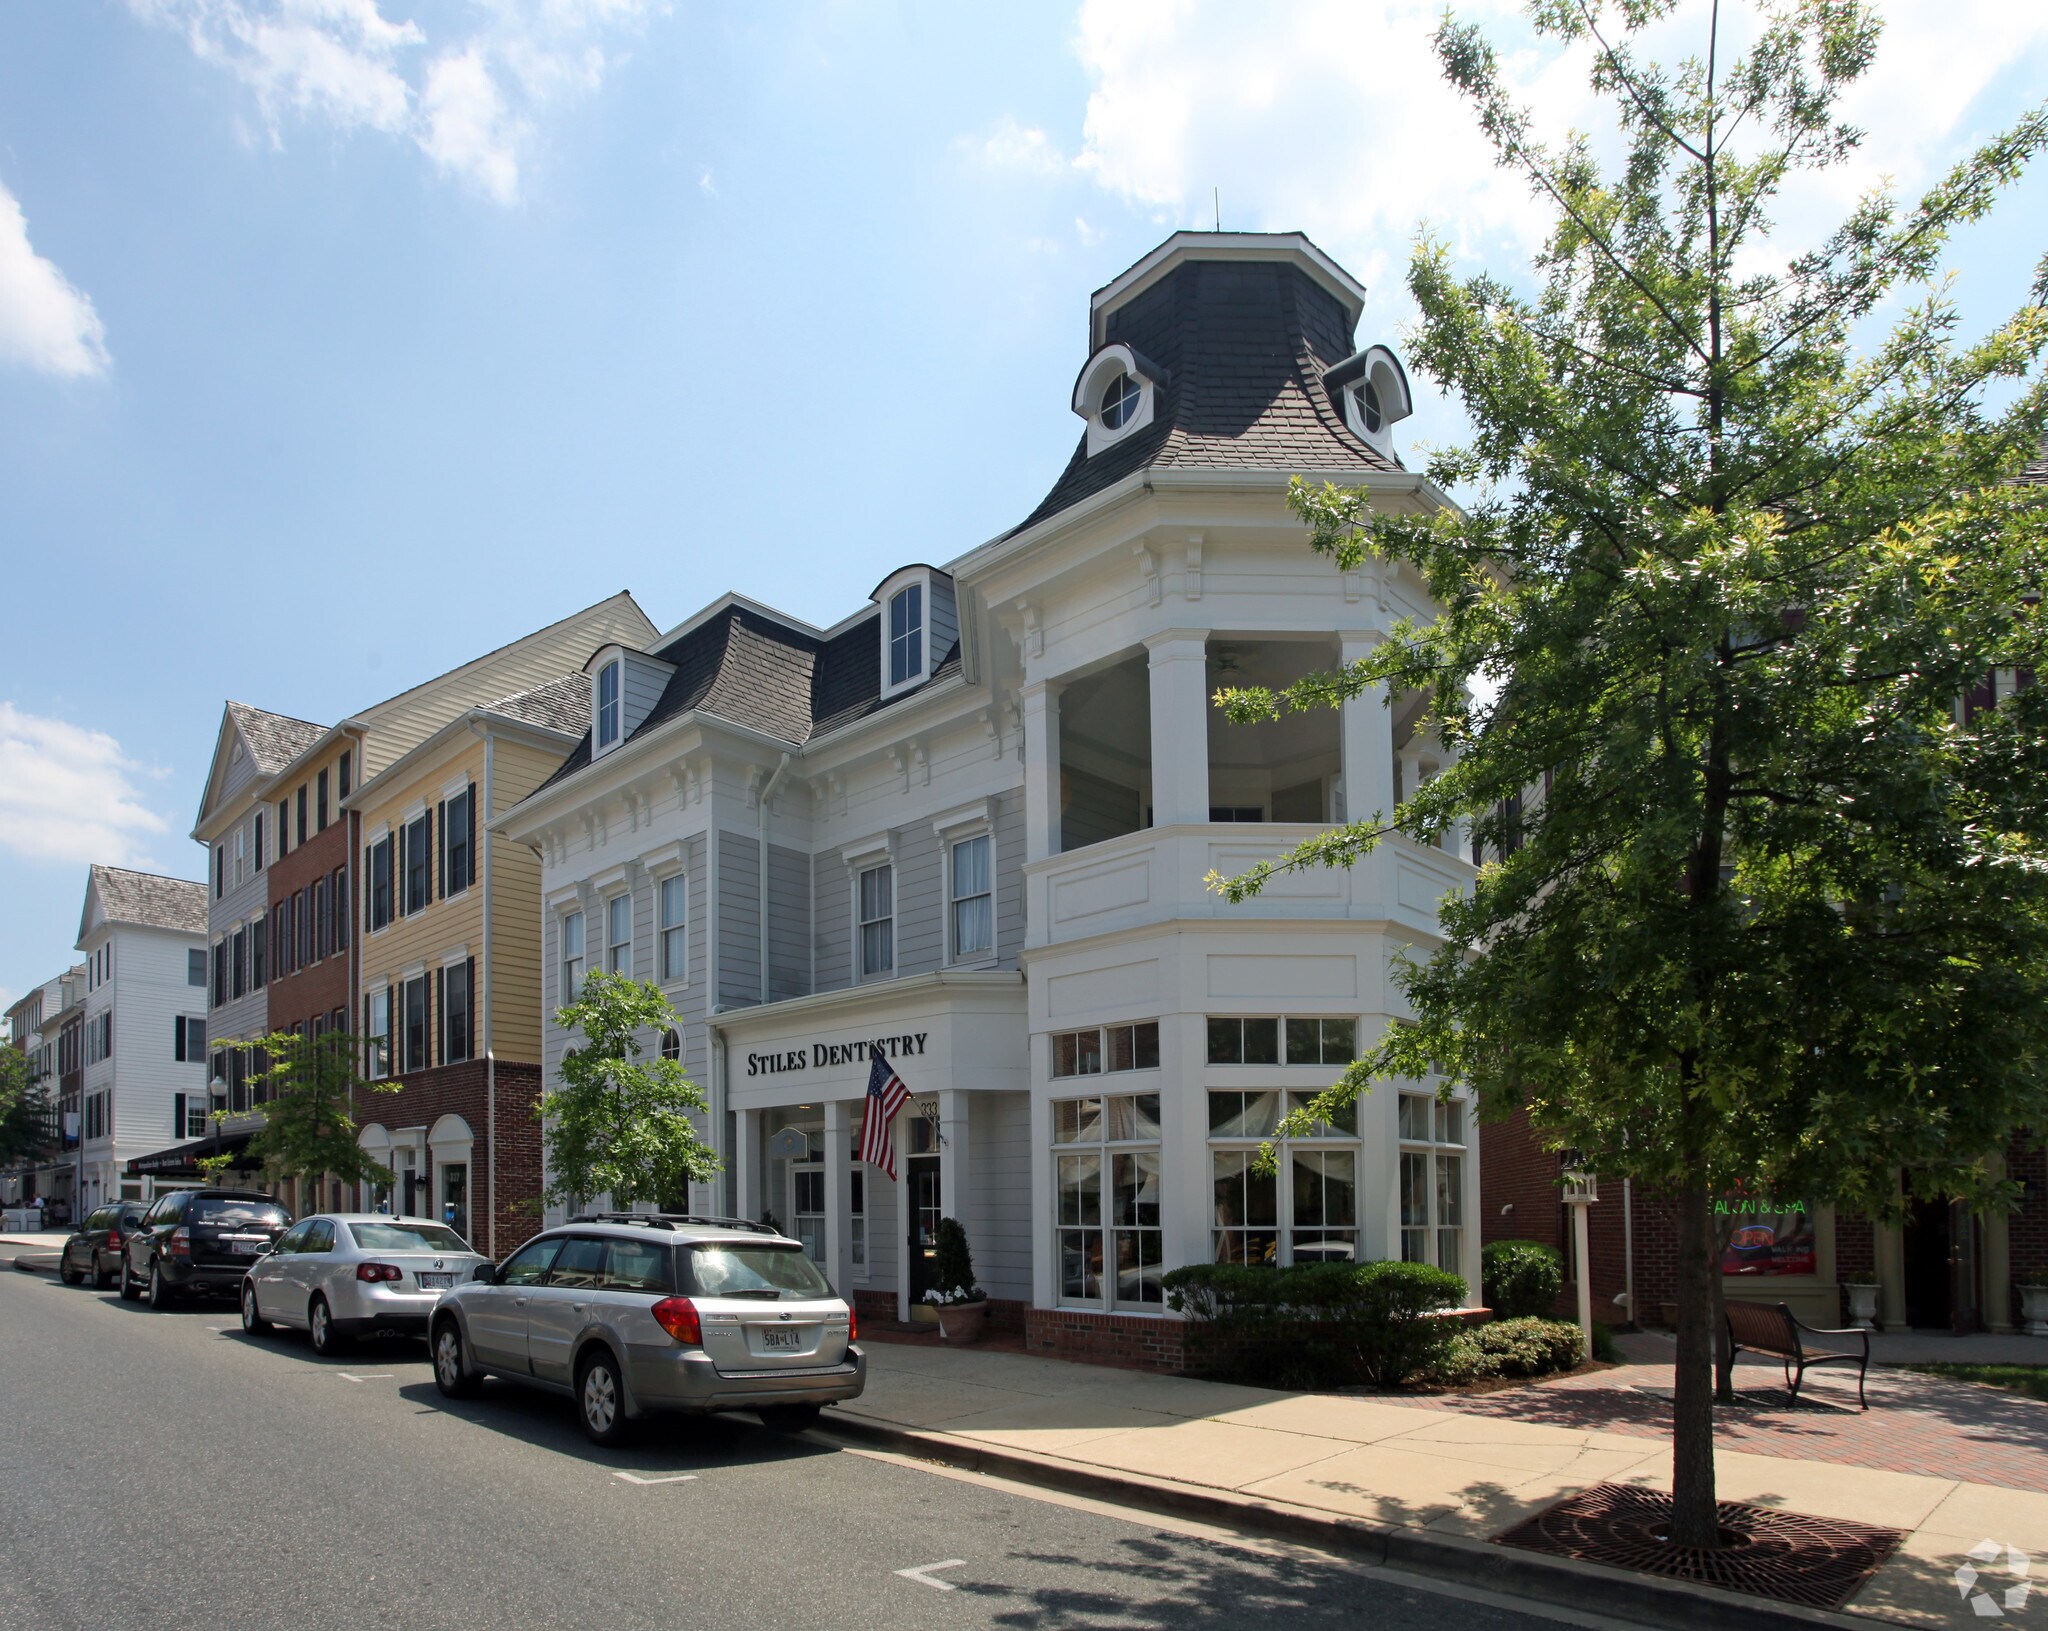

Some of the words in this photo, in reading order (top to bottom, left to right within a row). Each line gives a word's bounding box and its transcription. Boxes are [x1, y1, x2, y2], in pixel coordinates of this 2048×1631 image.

[747, 1050, 807, 1077] STILES
[812, 1032, 929, 1068] DENTISTRY
[920, 1101, 938, 1117] 333
[1706, 1199, 1757, 1215] ALON
[1760, 1199, 1771, 1215] &
[1730, 1230, 1775, 1247] OPEN
